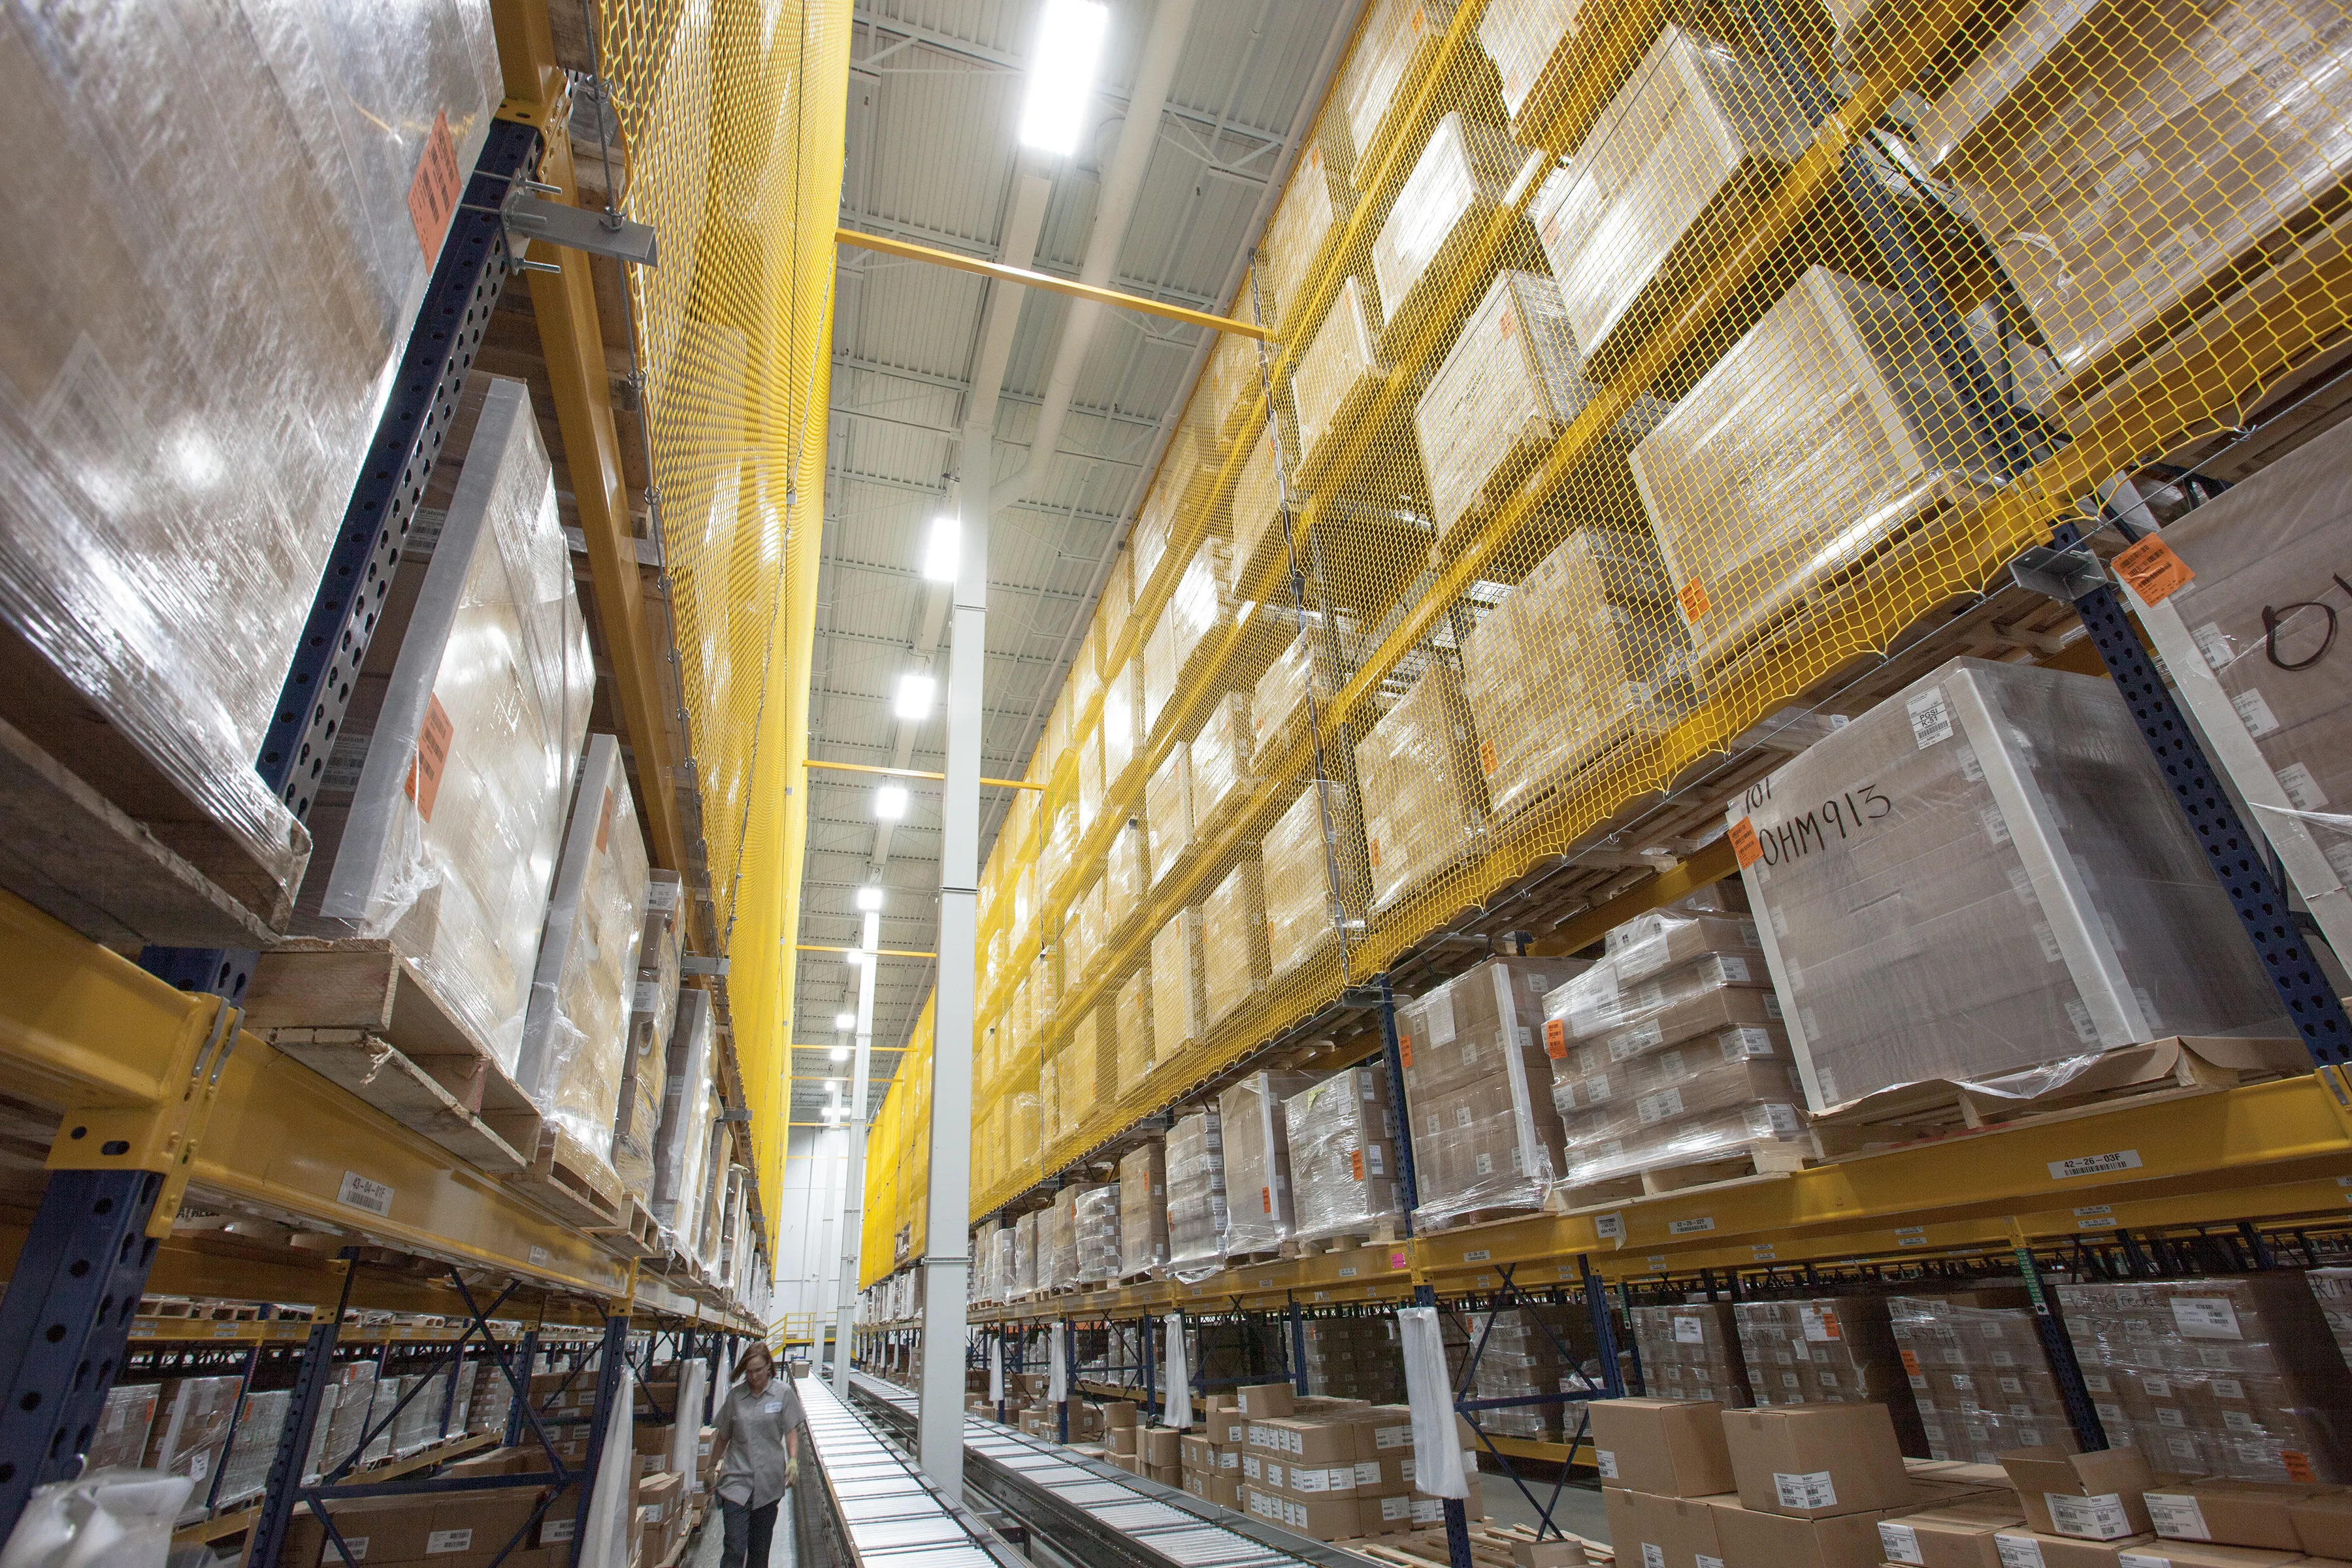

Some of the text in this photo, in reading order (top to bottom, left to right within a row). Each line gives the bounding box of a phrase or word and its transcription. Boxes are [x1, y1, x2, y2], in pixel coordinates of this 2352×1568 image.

[1919, 708, 1938, 721] PGSI
[1921, 715, 1938, 727] K-51
[1759, 783, 1891, 866] OHM913
[2064, 1153, 2121, 1168] 42-26-03F
[353, 1177, 386, 1198] 43-04-01F
[2308, 1274, 2352, 1301] RIT
